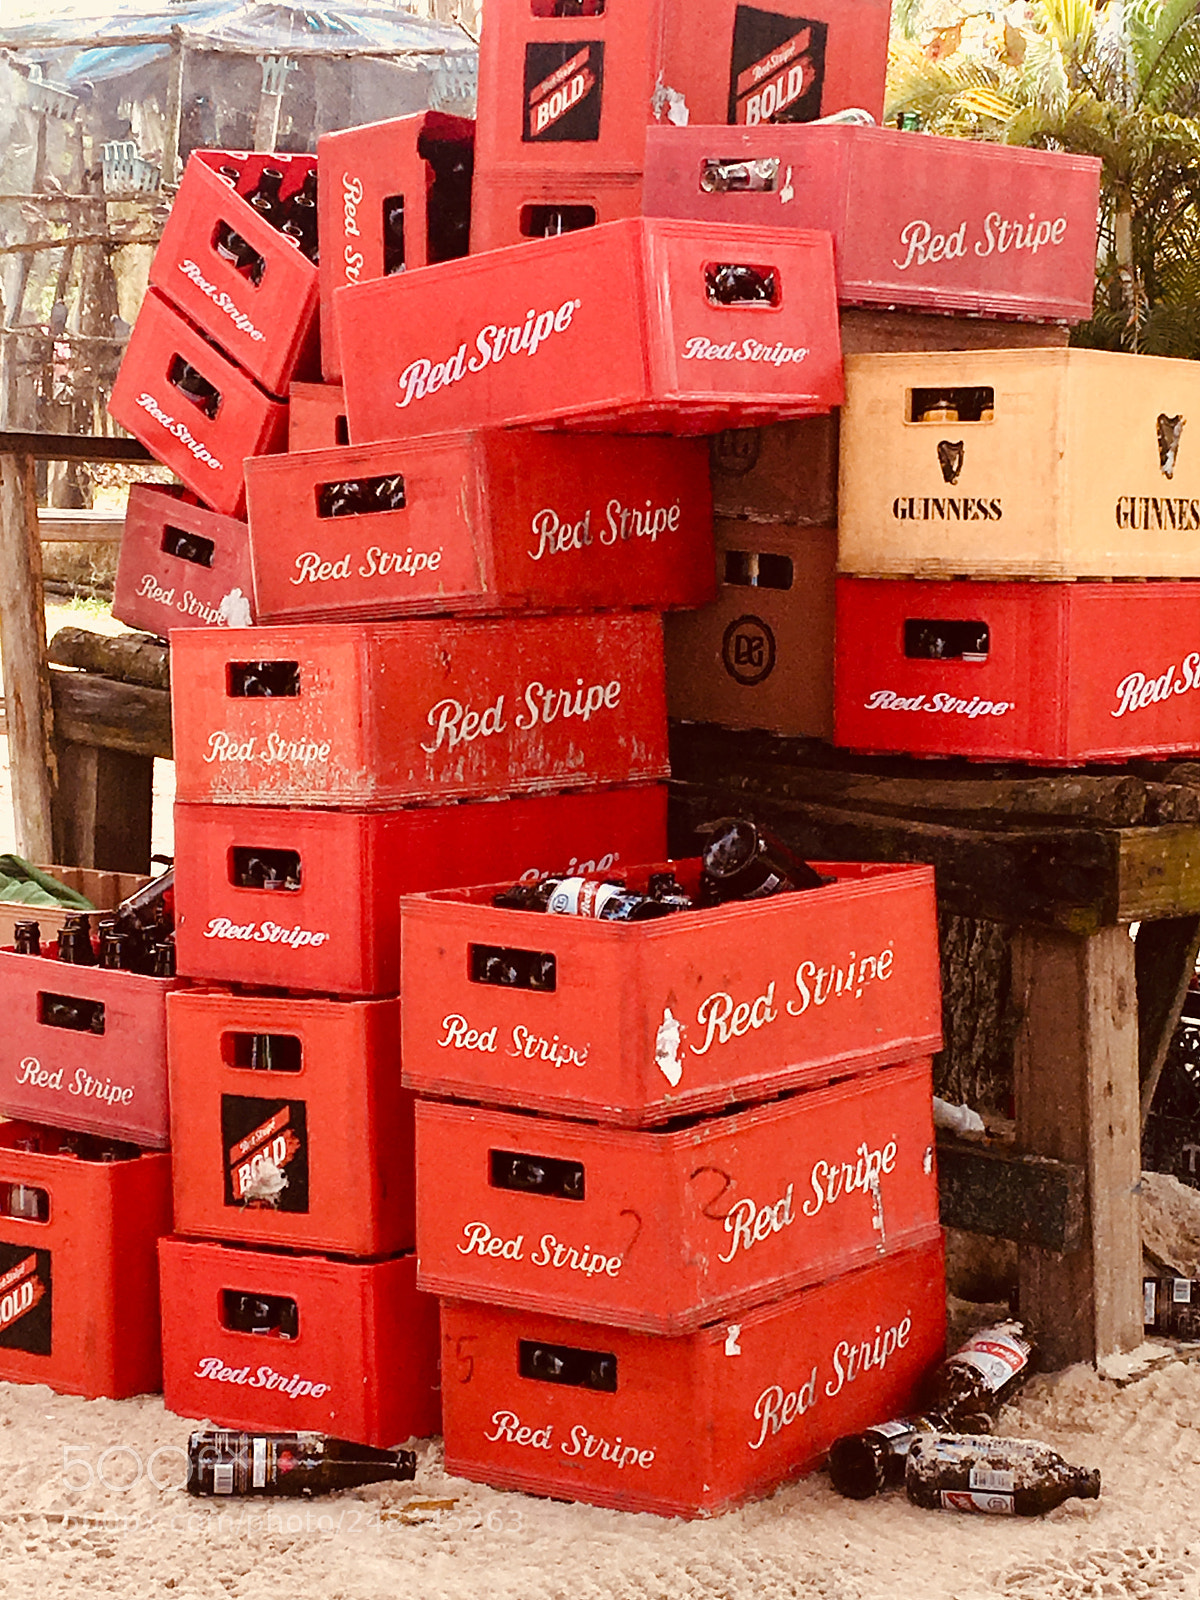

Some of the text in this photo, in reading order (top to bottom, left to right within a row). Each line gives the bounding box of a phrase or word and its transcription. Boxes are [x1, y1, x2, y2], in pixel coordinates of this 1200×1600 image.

[537, 74, 585, 131] BOLD
[745, 64, 804, 126] BOLD
[342, 171, 364, 287] Red St
[893, 211, 1067, 269] Red Stripe
[178, 259, 263, 342] Red Stripe
[395, 299, 574, 408] Red Stripe
[681, 336, 806, 367] Red Stripe
[136, 392, 222, 471] Red Stripe
[528, 499, 681, 561] Red Stripe
[892, 496, 1003, 521] GUINNESS
[1115, 495, 1200, 531] GUINNES
[289, 545, 442, 585] Red Stripe
[135, 574, 228, 628] Red Stripe
[420, 678, 622, 754] Red Stripe
[863, 690, 1010, 719] Red Stripe
[1109, 664, 1175, 718] Red
[203, 730, 331, 767] Red Stripe
[203, 917, 326, 949] Red Stripe
[437, 1013, 498, 1053] Red
[689, 981, 777, 1056] Red
[15, 1055, 134, 1106] Red Stripe
[717, 1138, 898, 1264] Red Stripe
[456, 1221, 623, 1277] Red Stripe
[0, 1280, 34, 1326] OLD
[194, 1356, 328, 1400] Red Stripe
[748, 1314, 912, 1450] Red Stripe
[483, 1410, 656, 1470] Red Stripe
